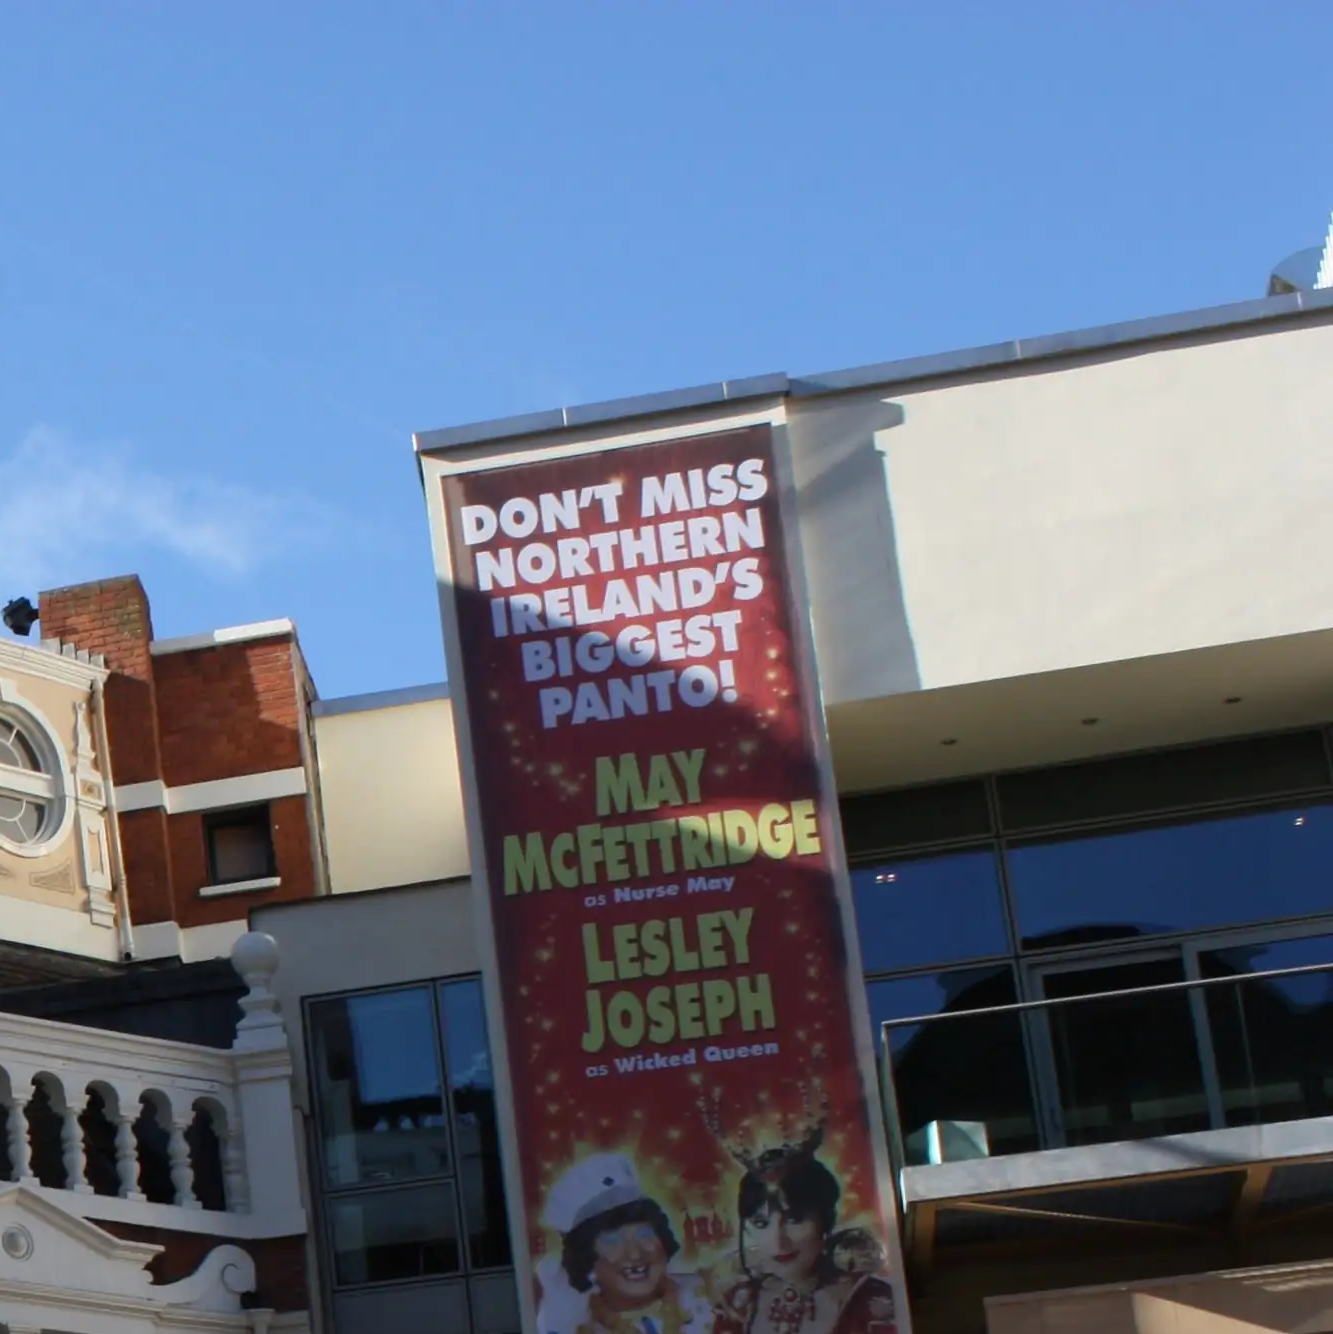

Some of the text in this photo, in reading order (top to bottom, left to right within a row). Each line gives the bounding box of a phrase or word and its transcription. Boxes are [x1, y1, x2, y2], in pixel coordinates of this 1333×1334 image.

[461, 459, 769, 546] DON'T MISS
[475, 508, 765, 591] NORTHERN
[490, 558, 763, 638] IRELAND'S
[521, 610, 743, 681] BIGGEST
[539, 659, 738, 729] PANTO!
[595, 748, 706, 817] MAY
[583, 875, 735, 907] as Nurse May
[581, 907, 754, 984] LESLEY
[581, 973, 776, 1053] JOSEPH
[585, 1042, 779, 1078] as Wicked Queen
